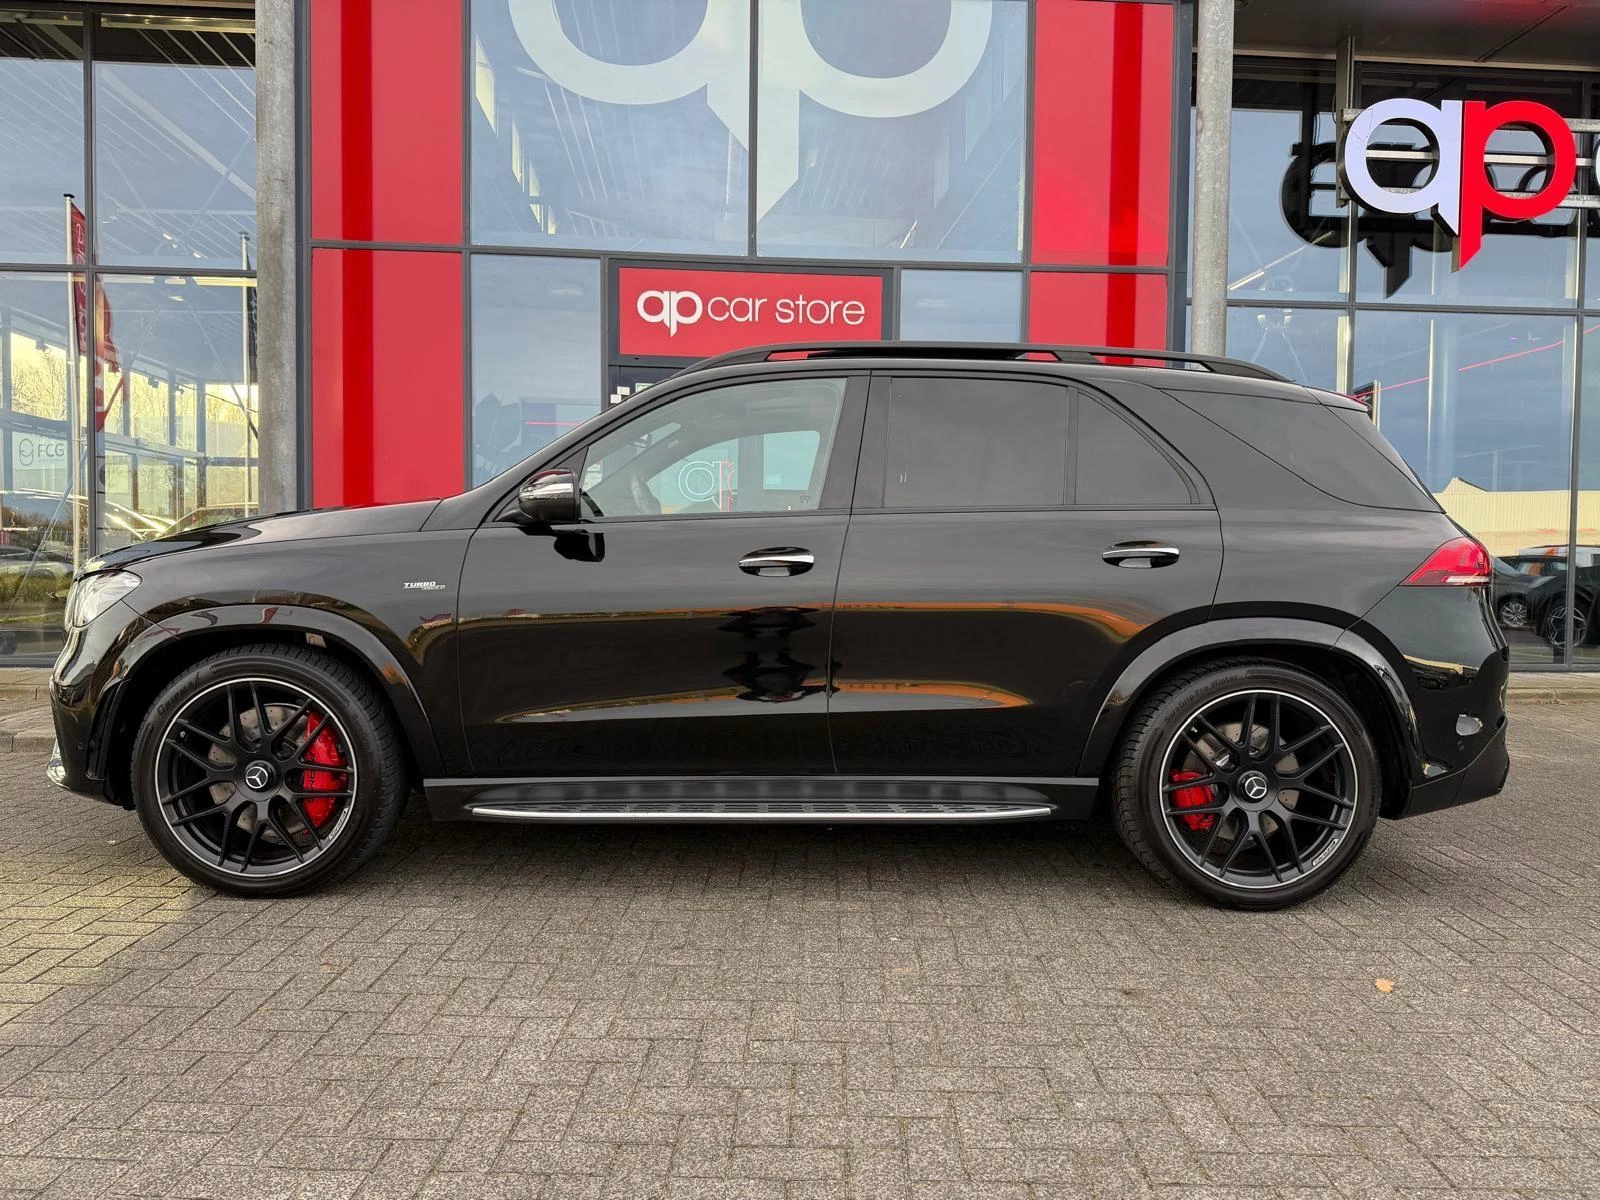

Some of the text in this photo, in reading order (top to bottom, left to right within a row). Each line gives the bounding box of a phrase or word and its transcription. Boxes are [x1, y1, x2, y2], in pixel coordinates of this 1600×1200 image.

[1344, 98, 1577, 269] ap
[637, 290, 865, 337] ap car store
[37, 443, 65, 457] FCG
[403, 581, 436, 589] TURBO
